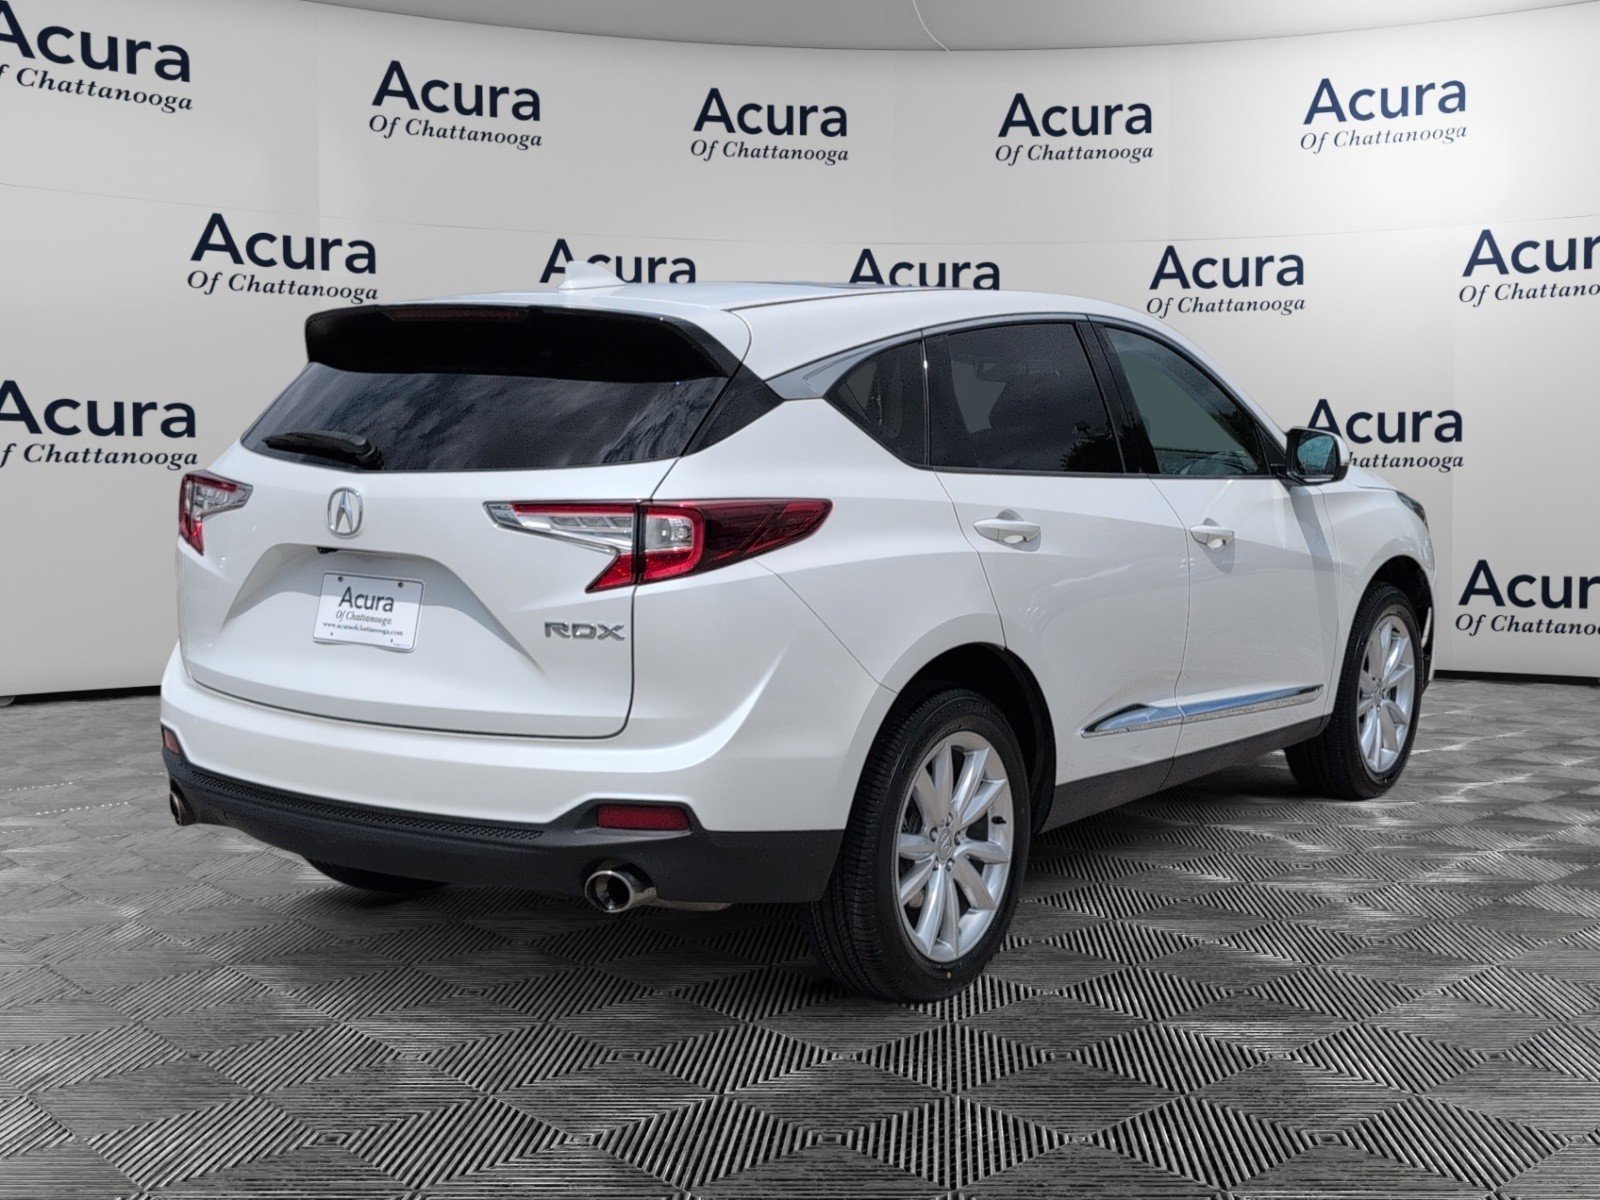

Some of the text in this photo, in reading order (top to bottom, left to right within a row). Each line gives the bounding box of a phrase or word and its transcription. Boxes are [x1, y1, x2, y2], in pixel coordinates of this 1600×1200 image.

[0, 0, 191, 83] Acura
[16, 67, 193, 114] Chattanooga
[371, 60, 541, 122] Acura
[1303, 77, 1466, 125] Acura
[692, 87, 848, 138] Acura
[997, 92, 1153, 138] Acura
[368, 114, 542, 151] Of Chattanooga
[1300, 126, 1467, 154] Of Chattanooga
[690, 139, 849, 166] Of Chattanooga
[995, 143, 1154, 167] Of Chattanooga
[189, 212, 377, 275] Acura
[1461, 228, 1600, 277] Acur
[1148, 244, 1306, 291] Acura
[187, 270, 378, 304] Of Chattanooga
[1458, 284, 1491, 308] Of
[1146, 296, 1306, 320] Of Chattanooga
[0, 379, 197, 439] Acura
[1308, 398, 1463, 445] Acura
[23, 443, 198, 471] Chattanooga
[1350, 451, 1464, 473] hattanooga
[338, 586, 394, 612] Acura
[1457, 558, 1600, 610] Acur
[335, 609, 392, 625] Of Chattanooga
[544, 621, 625, 641] RDX
[1454, 613, 1487, 637] Of
